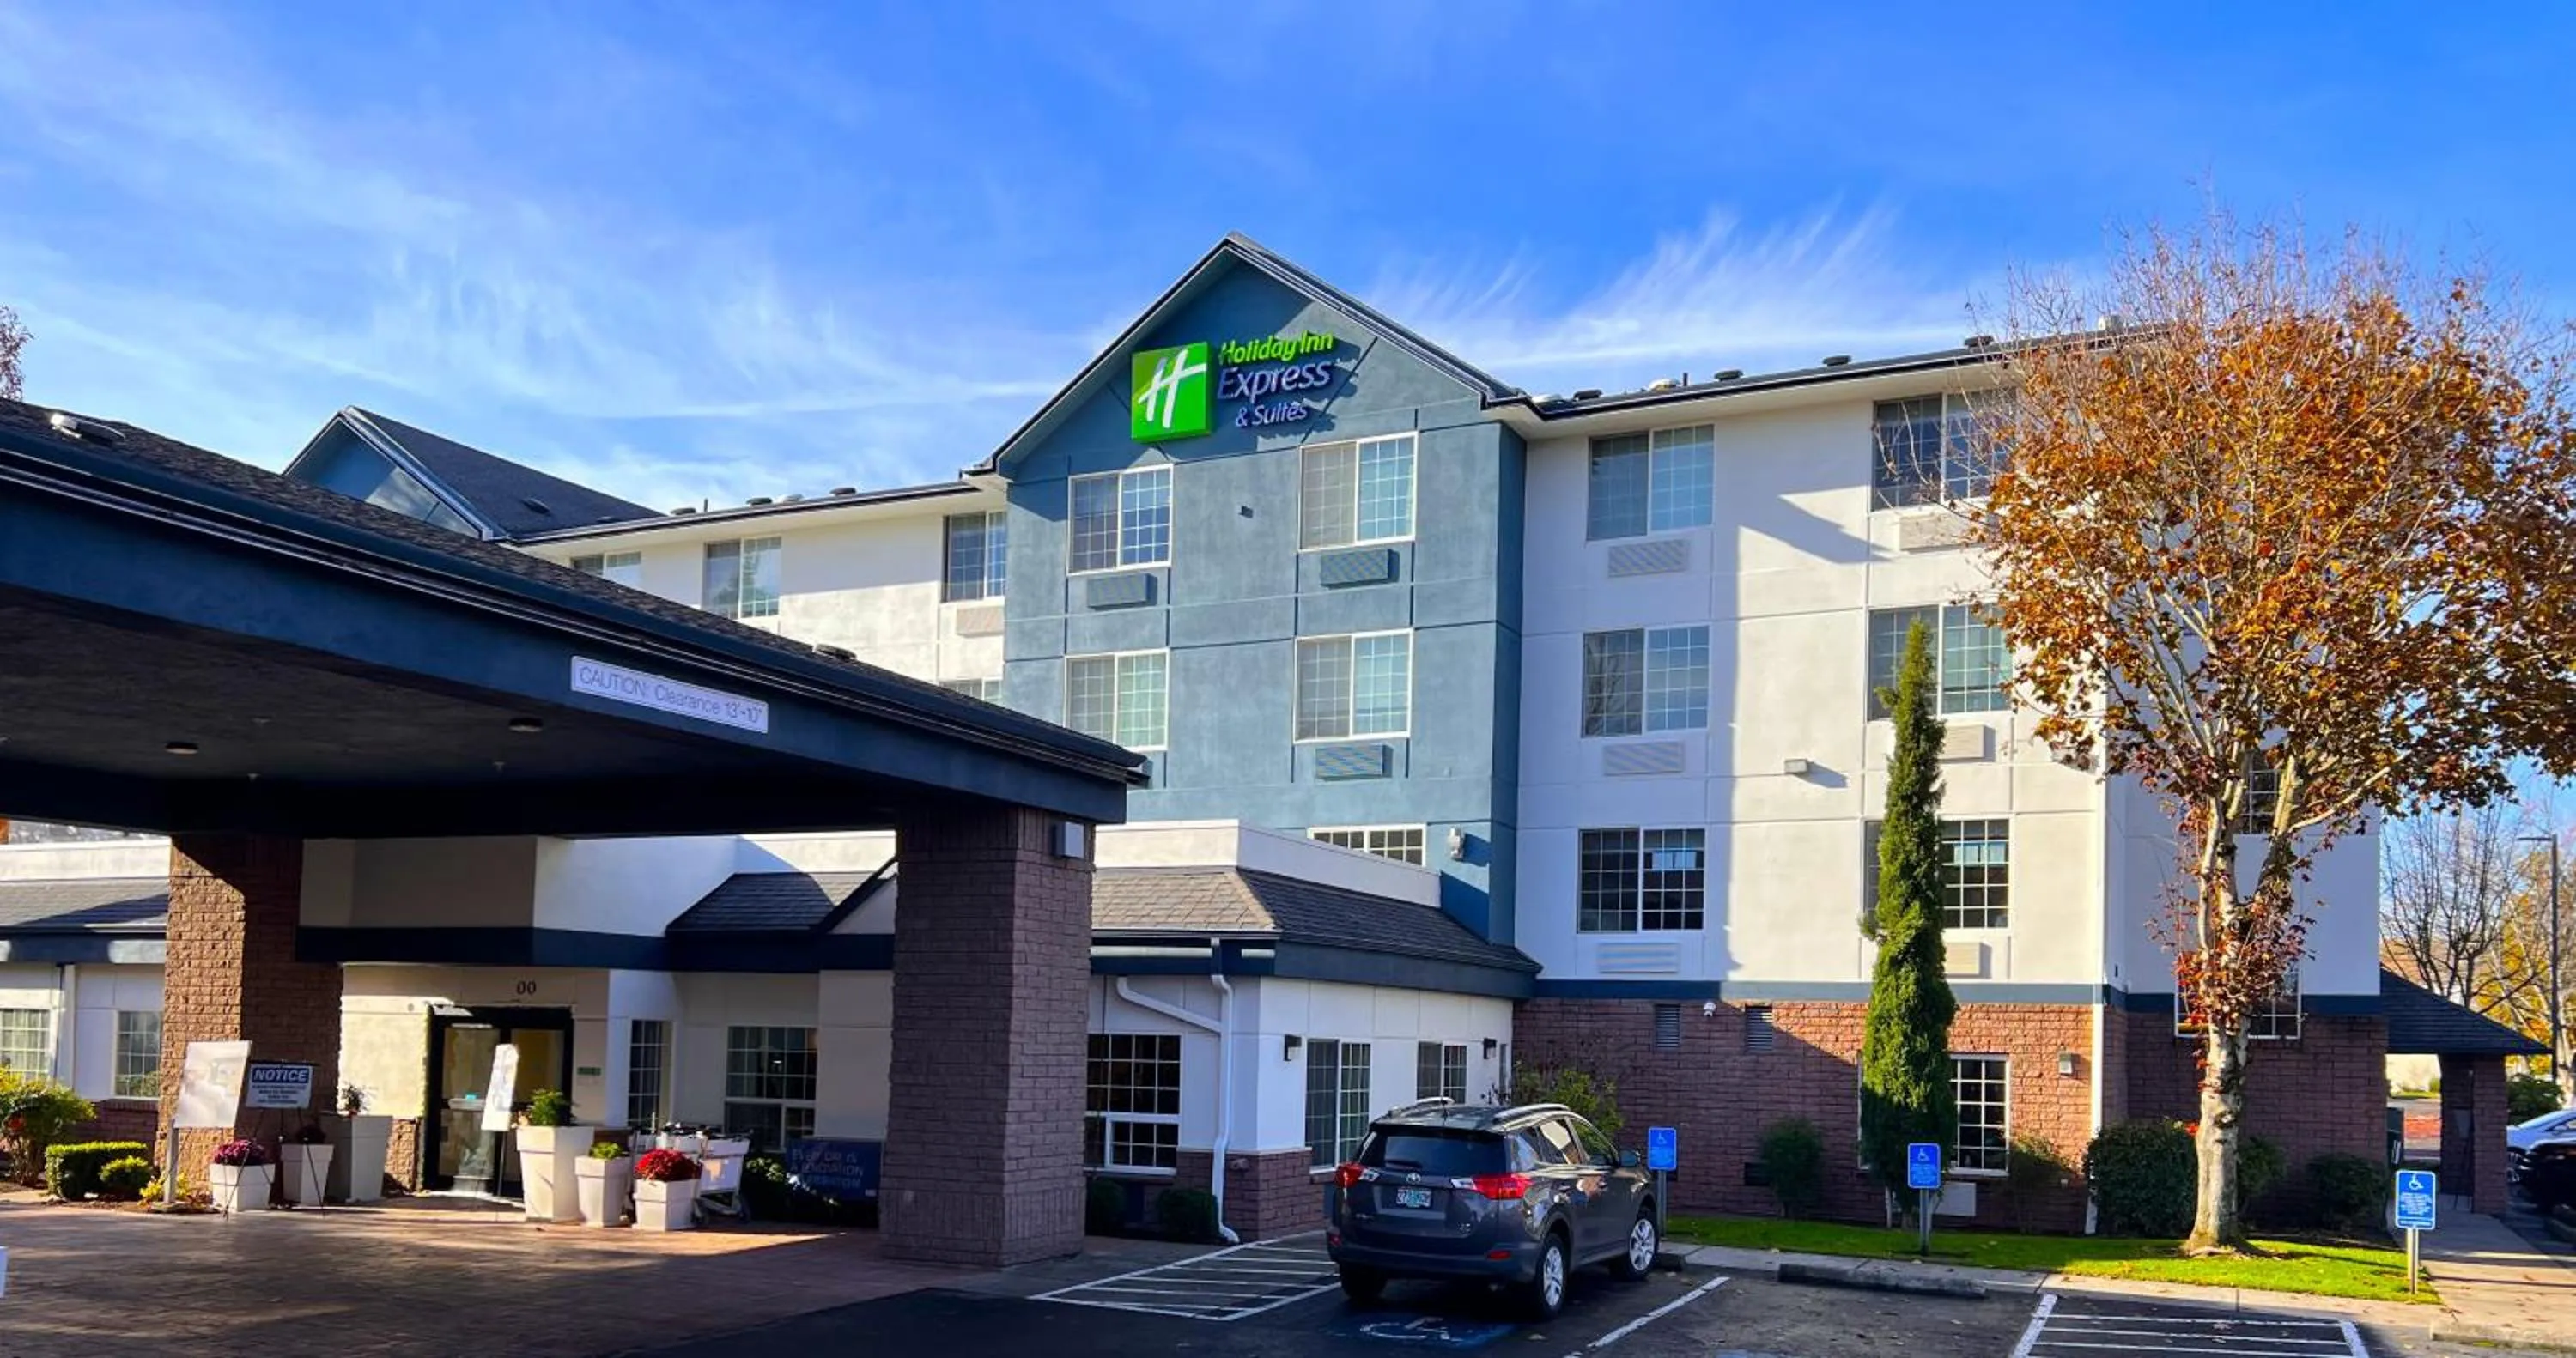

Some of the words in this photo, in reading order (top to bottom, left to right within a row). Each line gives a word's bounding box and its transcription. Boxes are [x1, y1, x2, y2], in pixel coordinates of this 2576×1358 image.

[1218, 337, 1297, 365] Holiday
[1299, 330, 1334, 353] Inn
[1218, 361, 1331, 402] Express
[1236, 408, 1248, 427] &
[1251, 401, 1309, 426] Suites
[654, 684, 720, 715] Clearance
[254, 1069, 307, 1082] NOTICE
